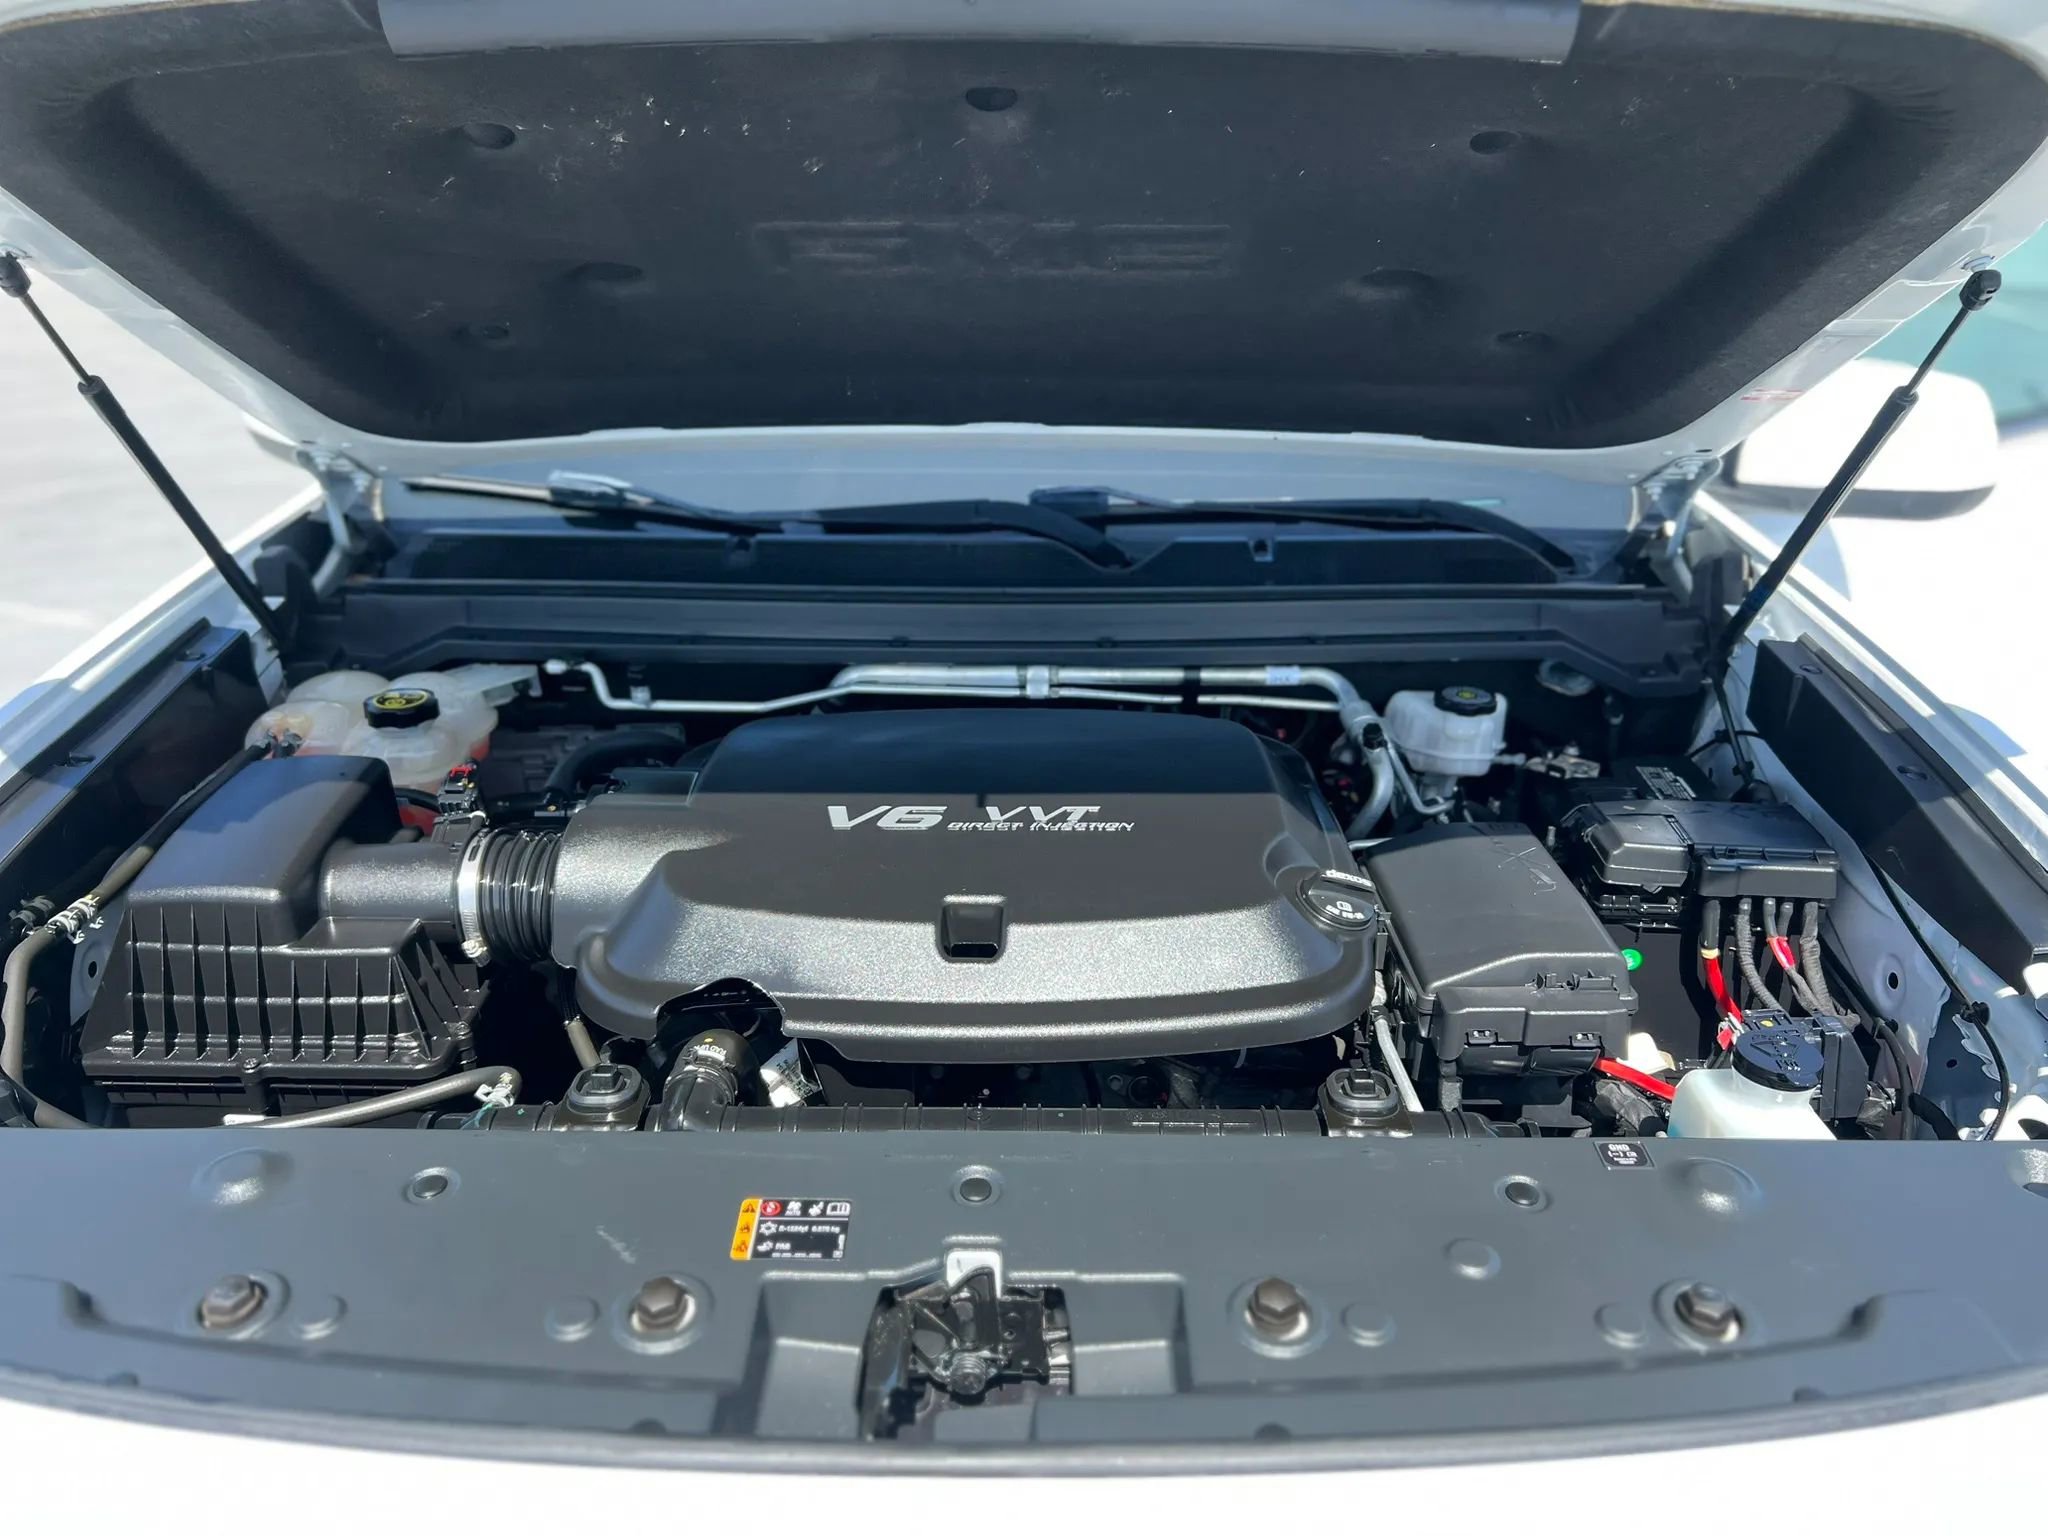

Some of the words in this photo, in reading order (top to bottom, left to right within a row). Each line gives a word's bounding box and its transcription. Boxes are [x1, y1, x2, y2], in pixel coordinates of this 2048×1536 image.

[827, 805, 948, 830] V6
[985, 805, 1101, 823] VVT
[947, 821, 1024, 832] DIRECT
[1029, 821, 1135, 832] INJECTION
